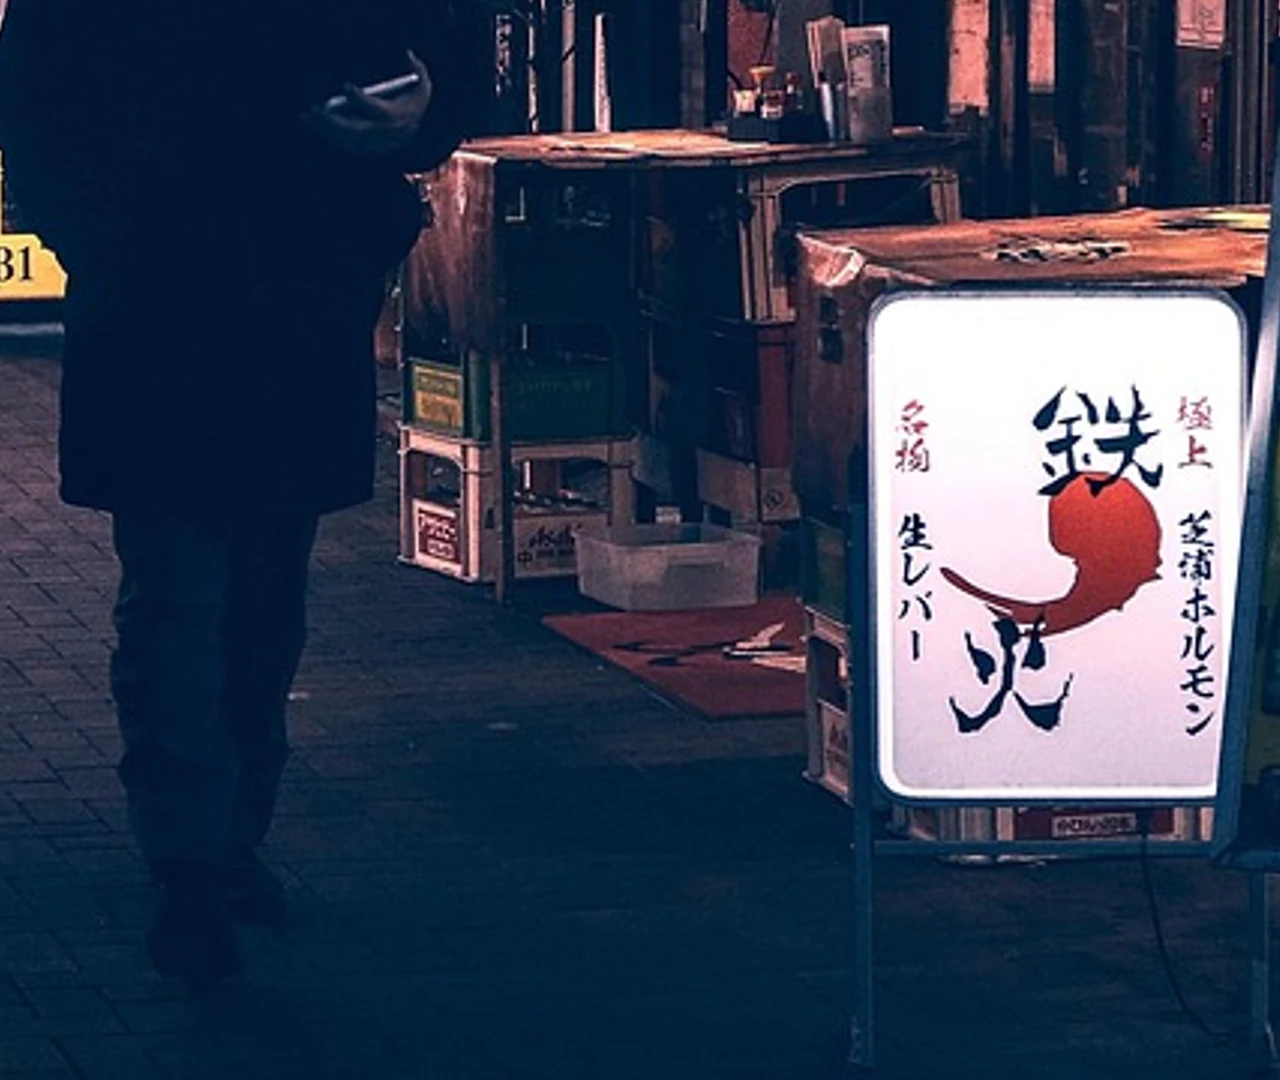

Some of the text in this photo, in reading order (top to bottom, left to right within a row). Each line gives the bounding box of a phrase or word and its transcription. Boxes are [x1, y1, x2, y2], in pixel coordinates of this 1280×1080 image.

[894, 398, 934, 662] 名物 生レバー
[1176, 395, 1216, 737] 極上 芝浦ホルモン
